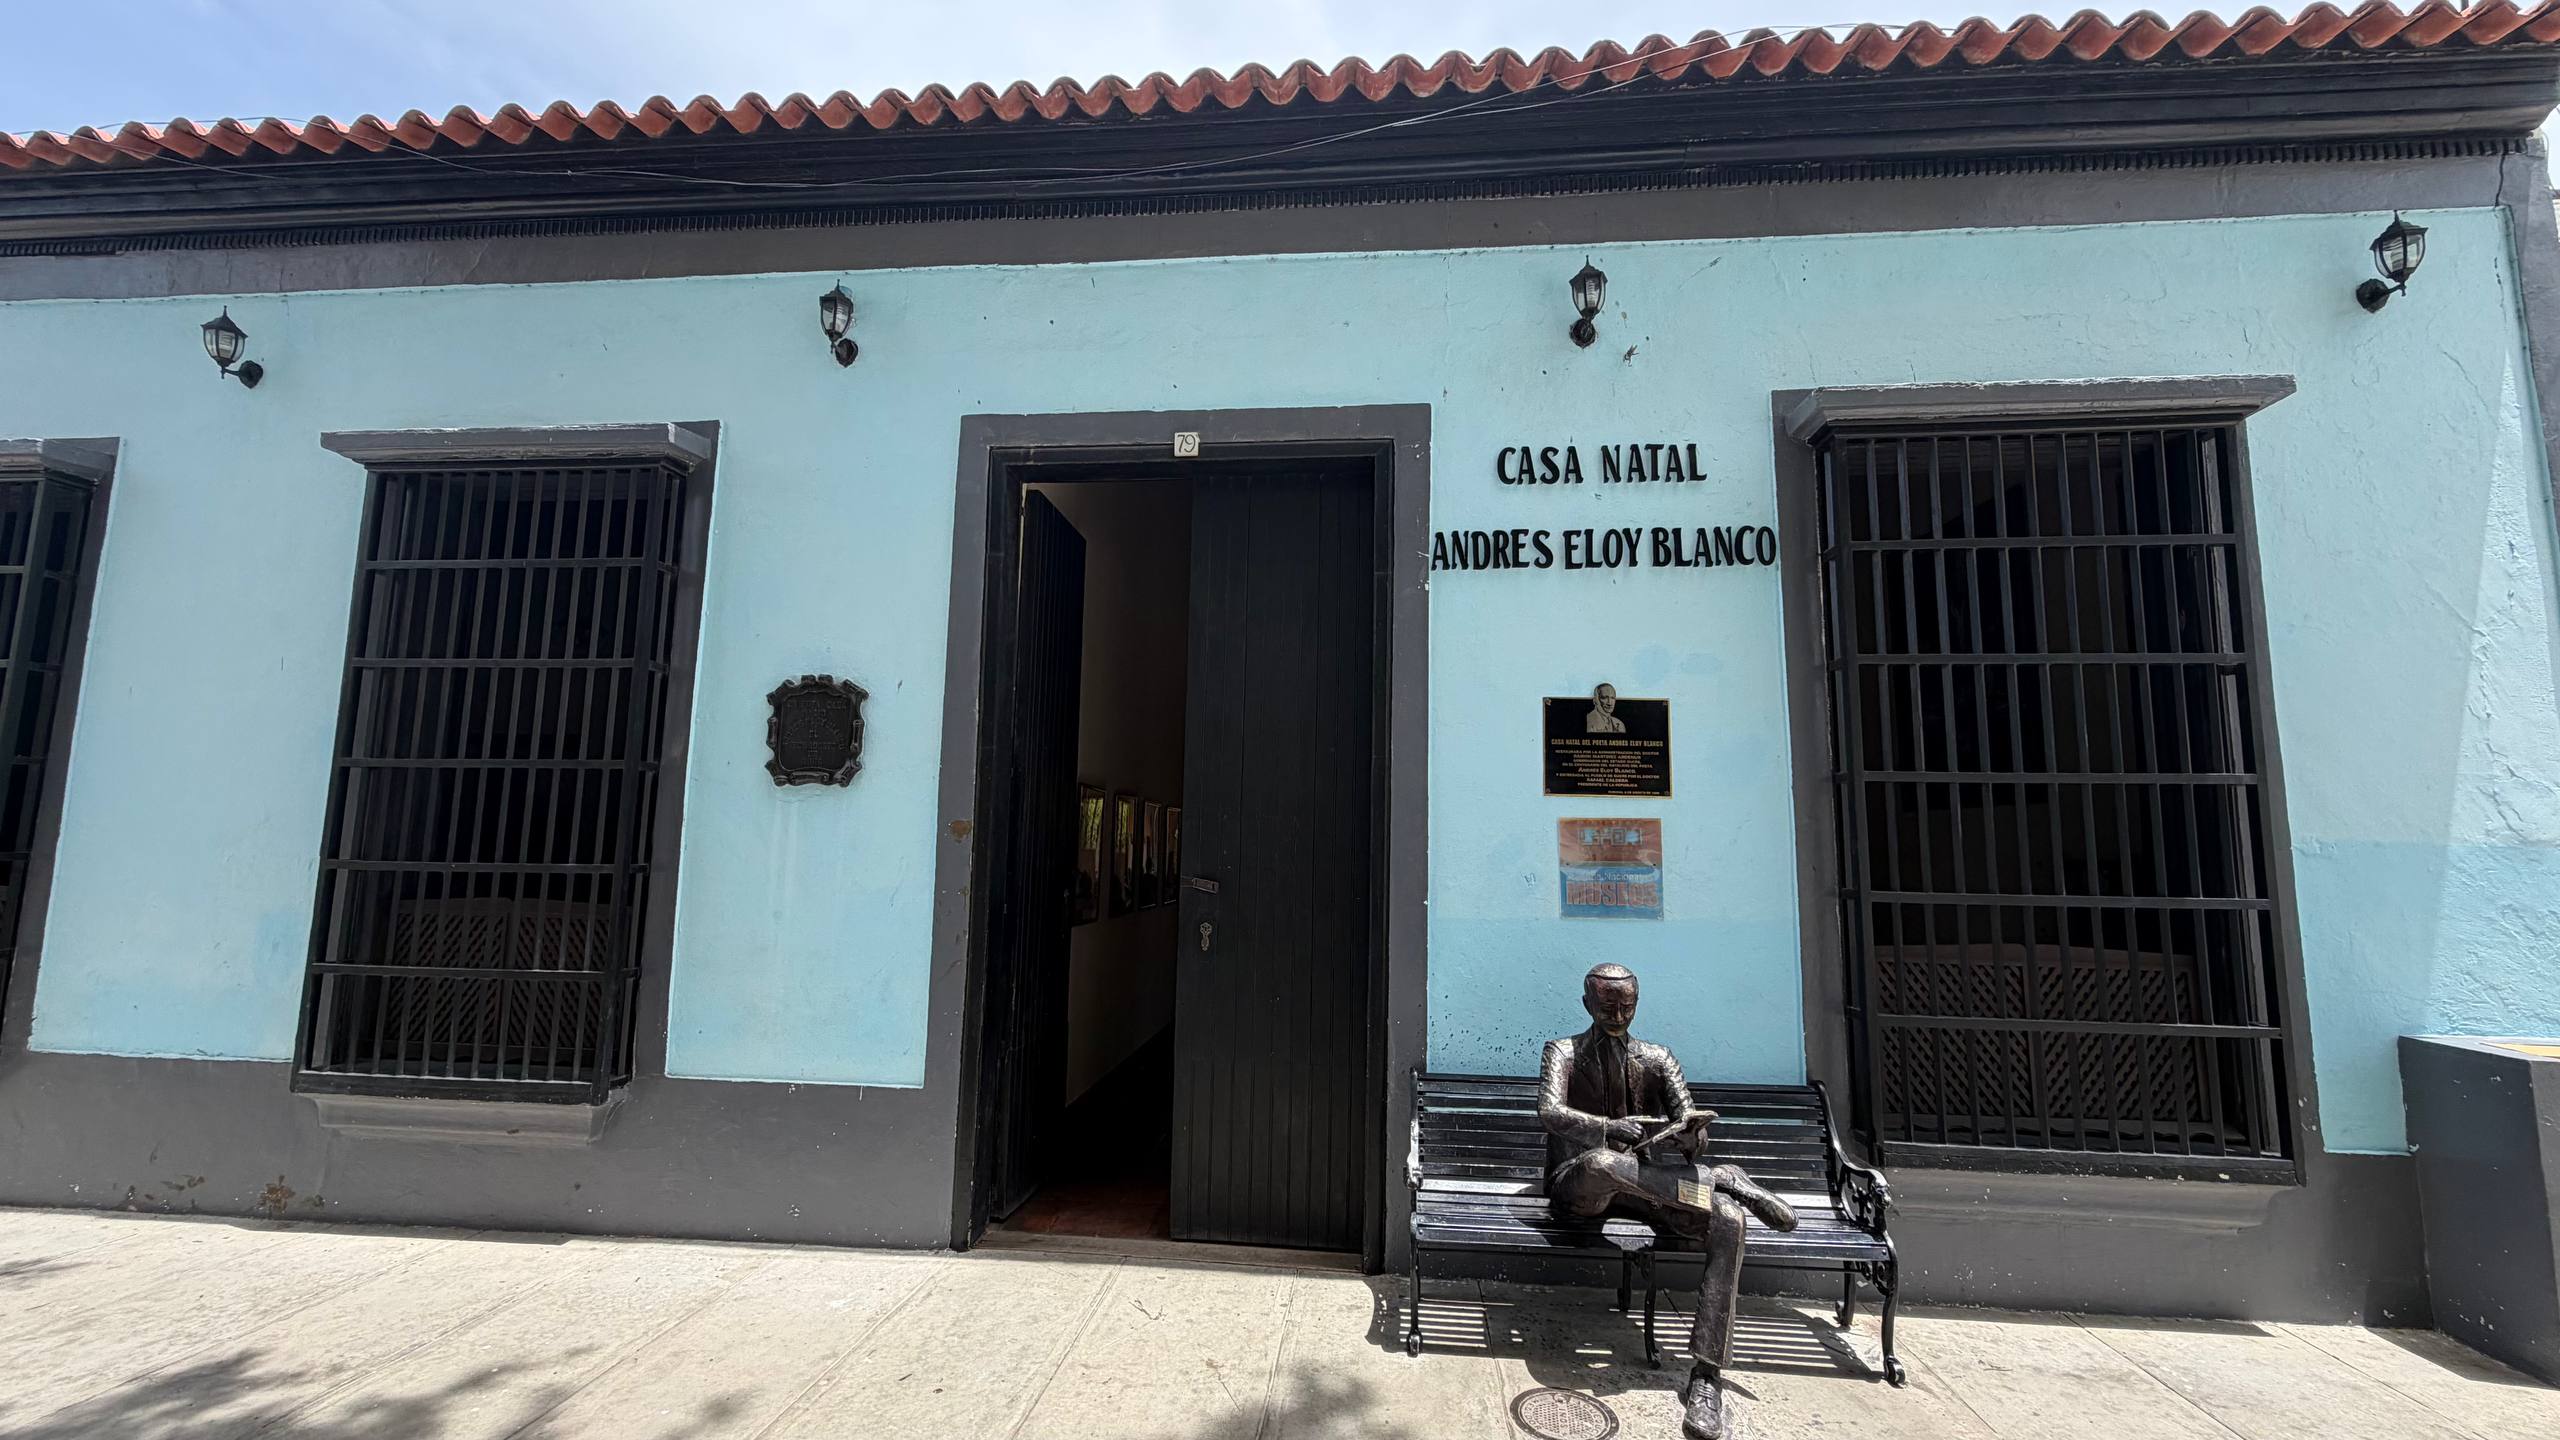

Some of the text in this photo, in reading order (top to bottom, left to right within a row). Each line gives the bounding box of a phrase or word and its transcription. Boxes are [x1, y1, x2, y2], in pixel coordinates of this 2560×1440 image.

[1177, 434, 1196, 453] 79
[1497, 443, 1708, 485] CASA NATAL
[1431, 525, 1777, 571] ANDRES ELOY BLANCO
[1558, 1408, 1569, 1429] INOS
